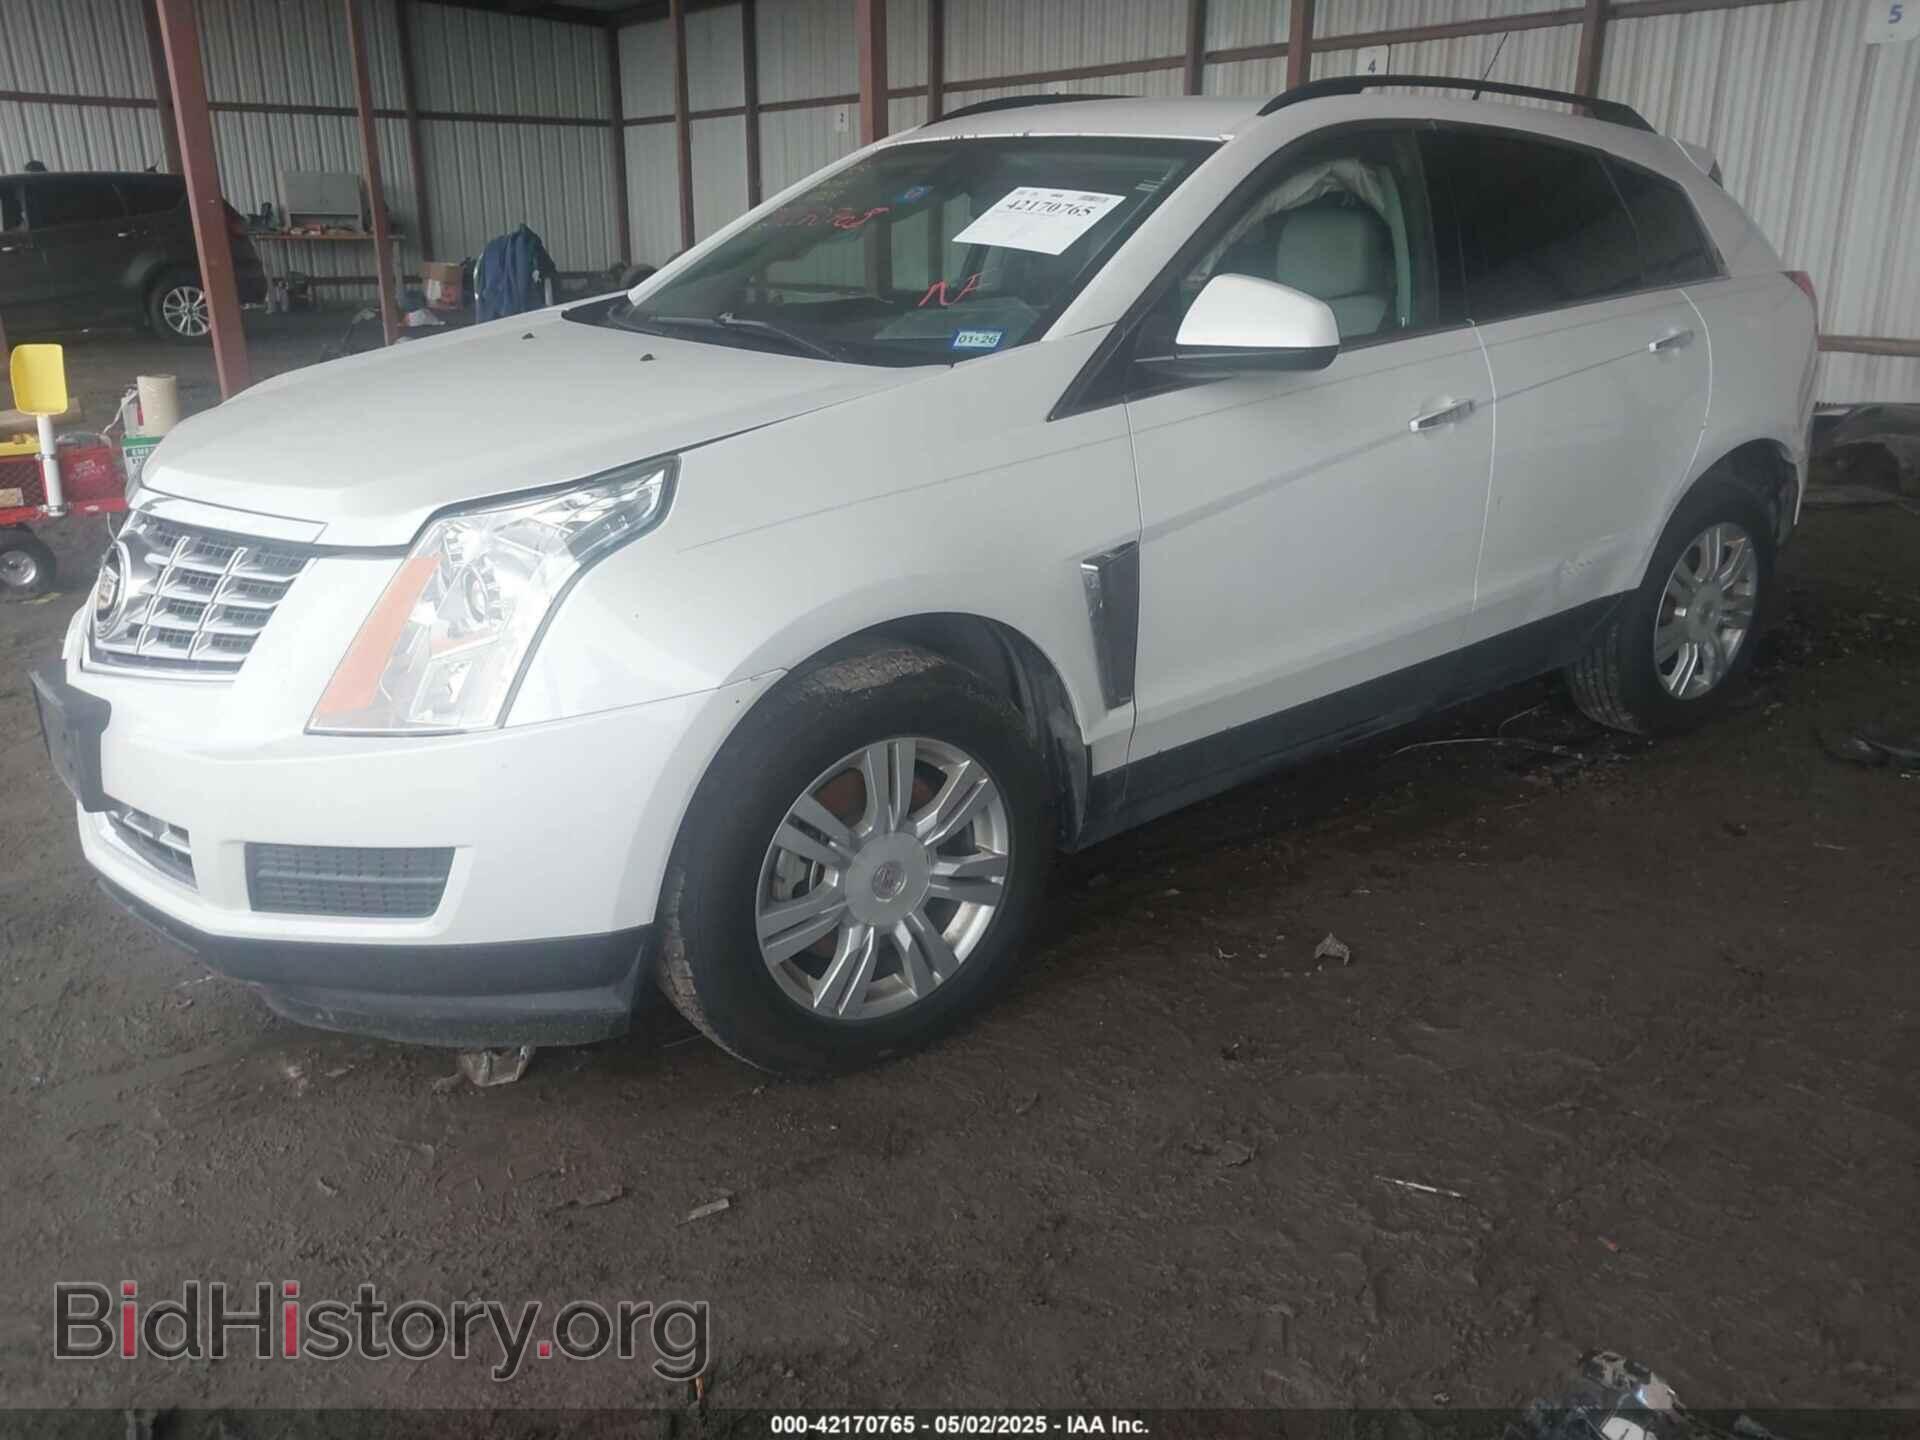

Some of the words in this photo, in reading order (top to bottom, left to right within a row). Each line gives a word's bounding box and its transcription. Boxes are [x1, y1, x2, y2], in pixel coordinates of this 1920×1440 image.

[1888, 4, 1904, 24] 5
[1367, 59, 1377, 73] 4
[1006, 198, 1096, 218] 42170765
